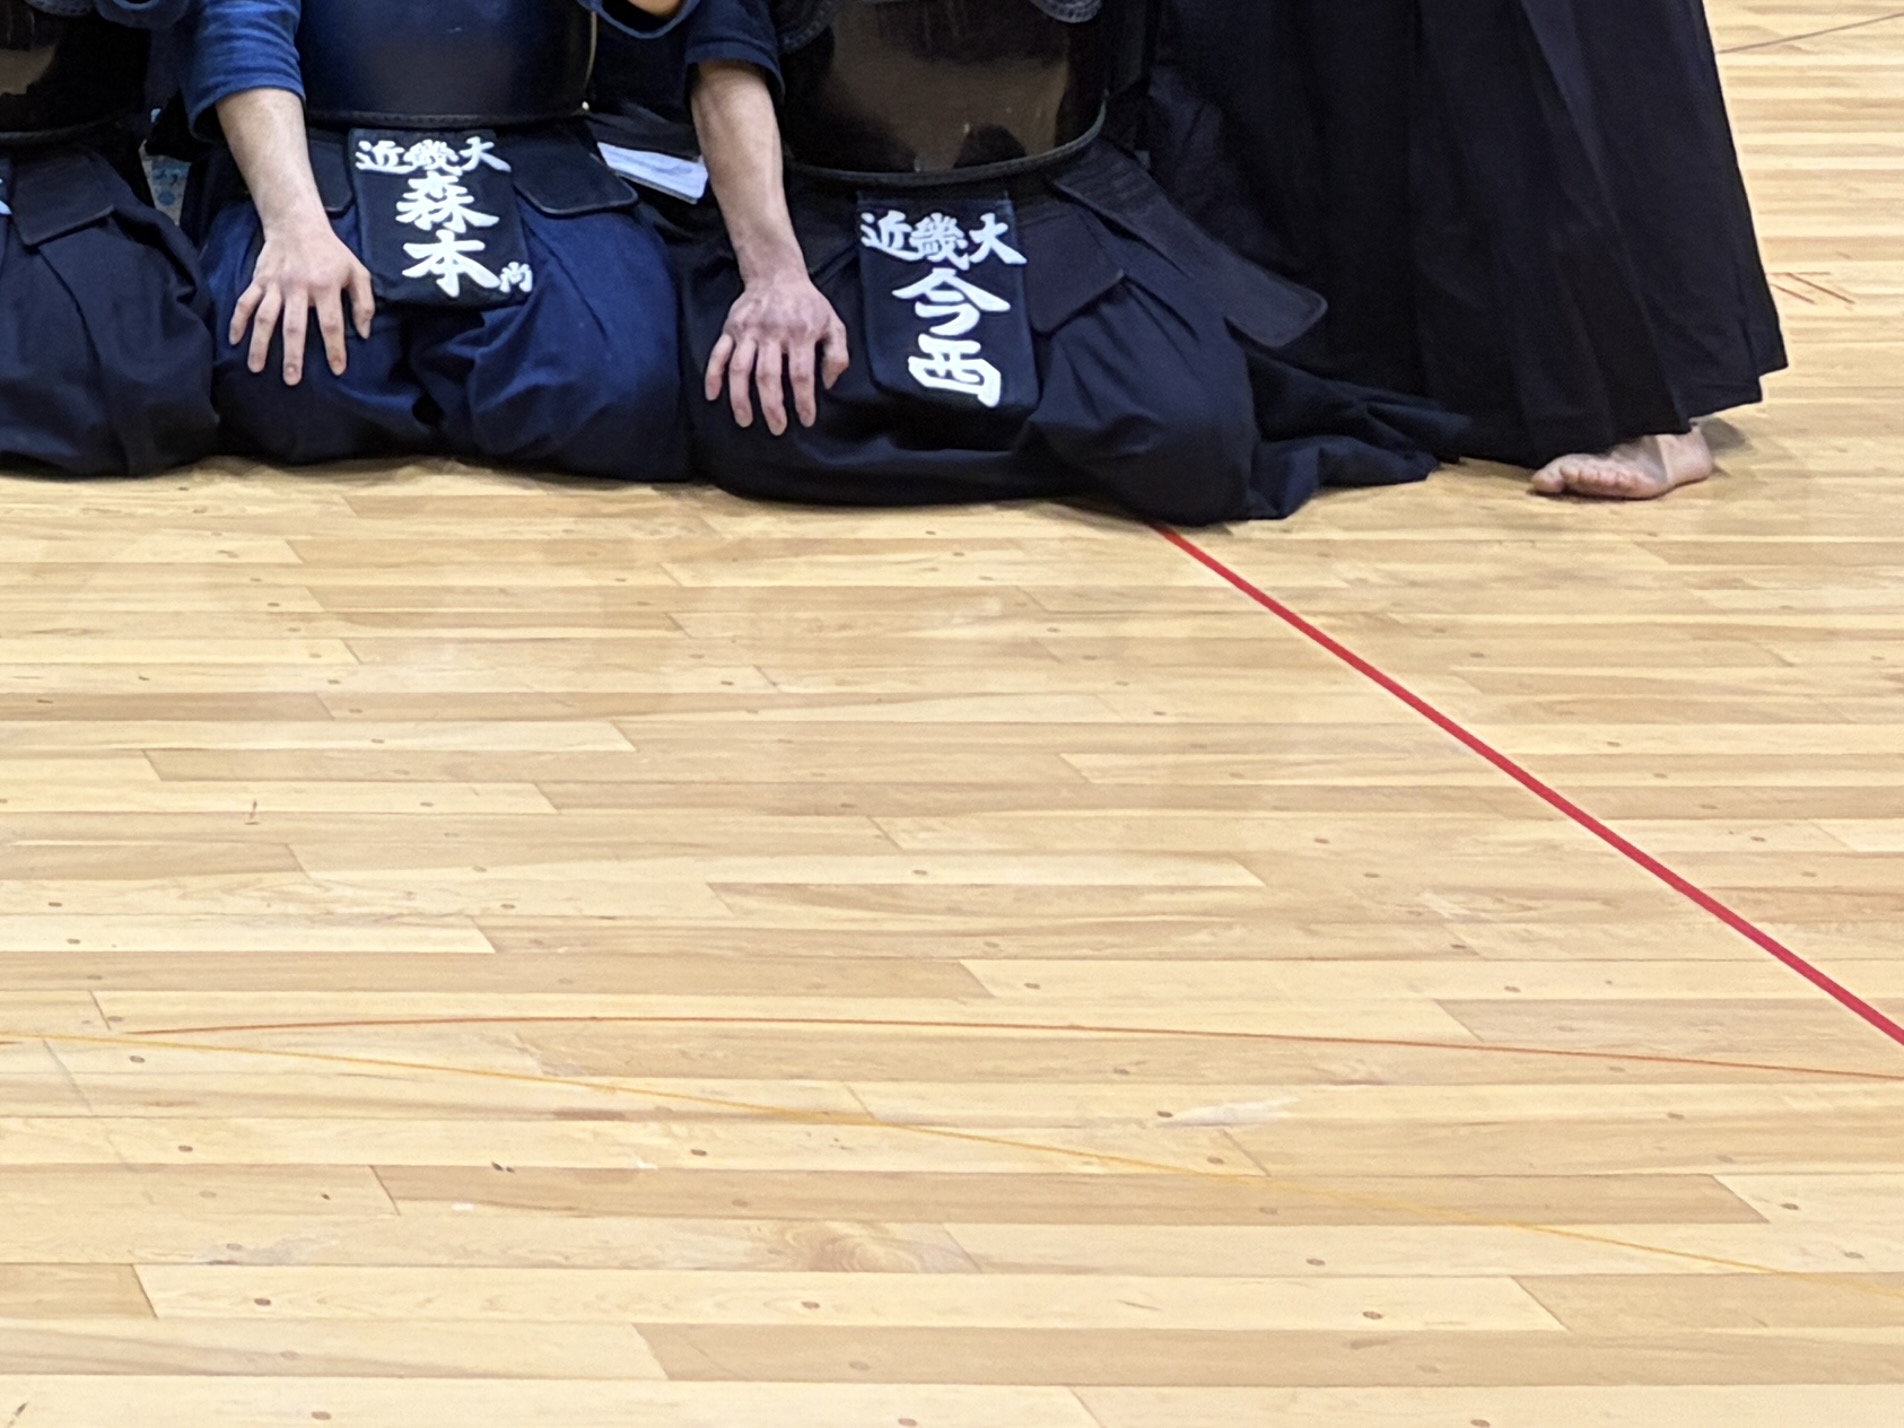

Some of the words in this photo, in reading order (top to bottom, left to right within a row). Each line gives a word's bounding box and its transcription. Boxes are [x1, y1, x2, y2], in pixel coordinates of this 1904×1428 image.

[355, 136, 512, 176] 近畿大
[395, 171, 501, 298] 森本
[860, 210, 1027, 270] 近畿大
[891, 267, 1011, 408] 今西
